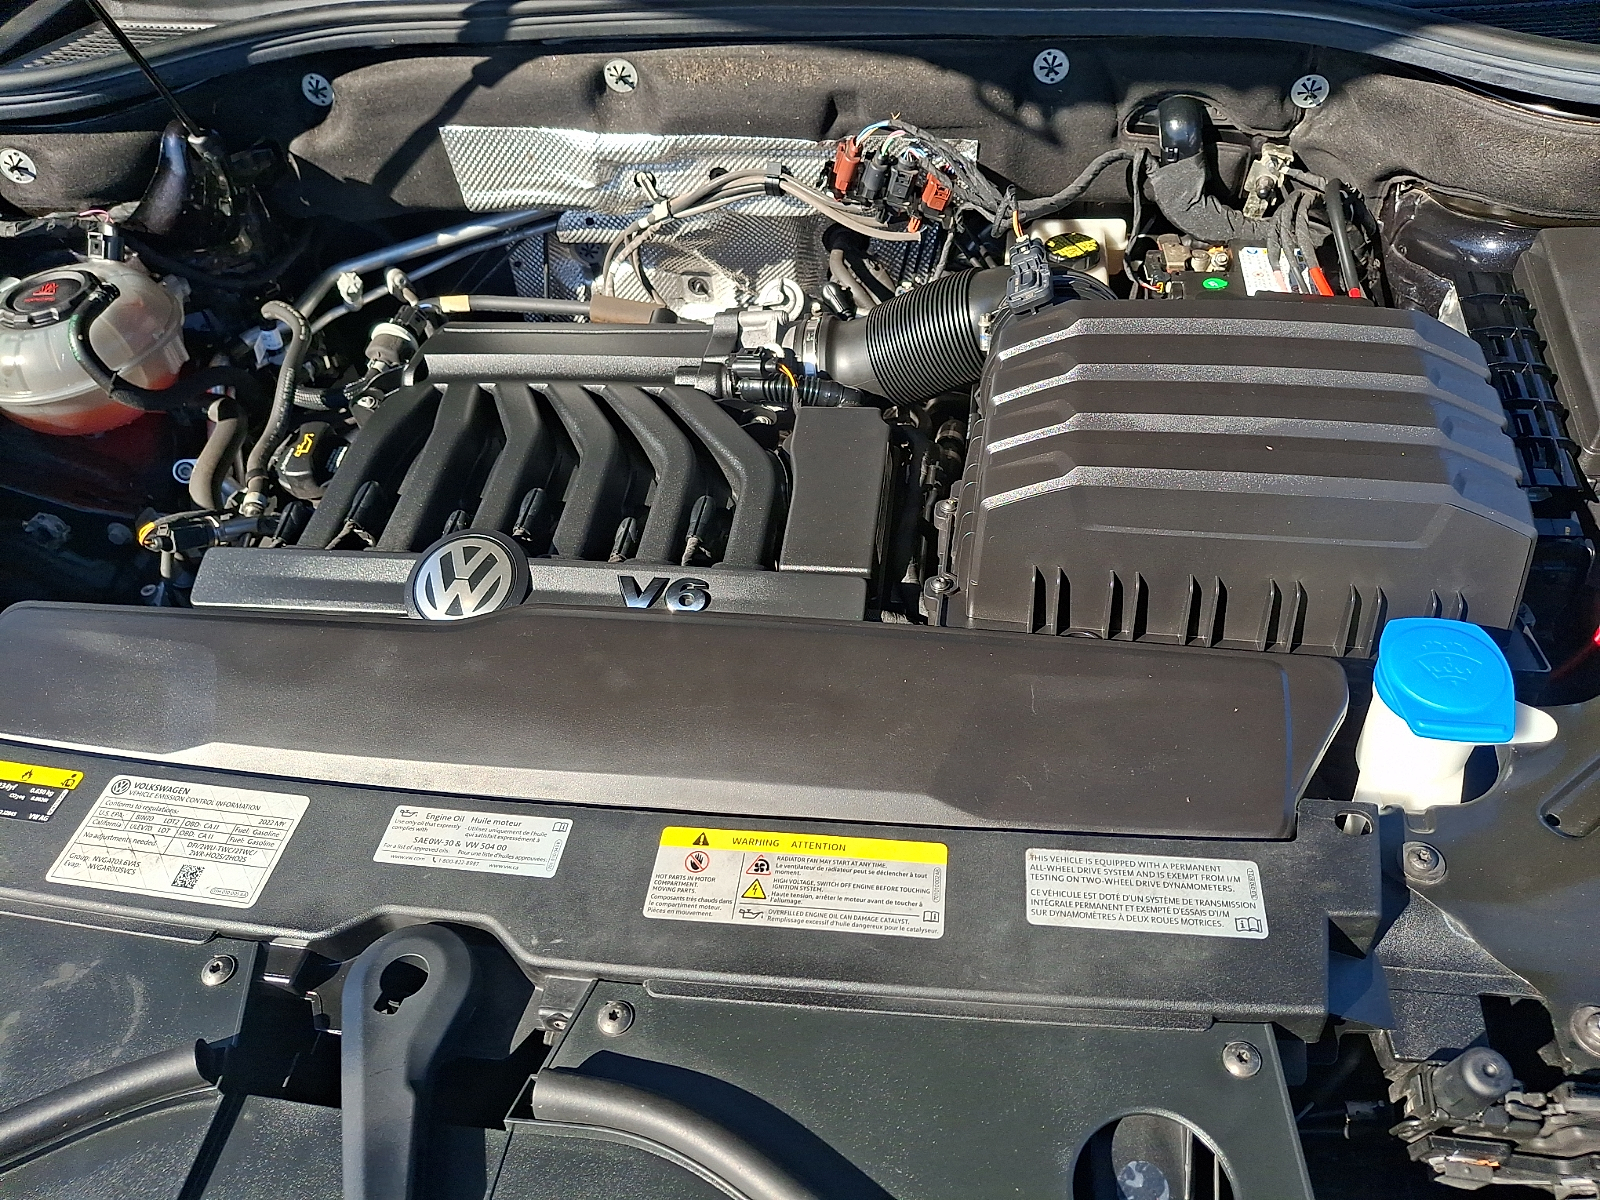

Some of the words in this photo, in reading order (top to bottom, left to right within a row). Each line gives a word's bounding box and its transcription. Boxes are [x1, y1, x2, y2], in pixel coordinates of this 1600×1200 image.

[618, 574, 711, 612] V6
[46, 789, 55, 797] kg
[134, 782, 191, 795] VOLKSWAGEN
[105, 799, 134, 808] Conforms
[129, 790, 154, 798] VEHICLE
[154, 793, 185, 802] EMISSION
[185, 796, 214, 806] CONTROL
[215, 800, 260, 811] INFORMATION
[425, 812, 452, 821] Engine
[470, 816, 491, 824] Huile
[492, 819, 522, 827] moteur
[252, 829, 280, 837] Gasoline
[246, 838, 275, 847] Gasoline
[479, 842, 495, 850] 504
[732, 837, 779, 847] WARNING
[790, 840, 846, 851] ATTENTION
[1049, 855, 1083, 864] VEHICLE
[1085, 857, 1093, 865] IS
[1094, 858, 1136, 867] EQUIPPED
[1137, 860, 1160, 868] WITH
[1170, 862, 1220, 872] PERMANENT
[876, 869, 908, 877] déclencher
[1029, 863, 1075, 873] ALL-WHEEL
[1077, 866, 1101, 875] DRIVE
[1103, 868, 1134, 876] SYSTEM
[1136, 870, 1156, 878] AND
[1157, 871, 1165, 879] IS
[1166, 872, 1198, 880] EXEMPT
[1200, 874, 1225, 882] FROM
[1226, 875, 1241, 883] I/M
[653, 879, 698, 887] COMPARTMENT.
[788, 878, 815, 886] VOLTAGE,
[875, 884, 898, 892] BEFORE
[899, 886, 930, 894] TOUCHING
[1031, 873, 1064, 882] TESTING
[1066, 875, 1079, 883] ON
[1080, 876, 1134, 886] TWO-WHEEL
[1135, 879, 1160, 888] DRIVE
[1162, 881, 1235, 892] DYNAMOMETERS.
[650, 893, 685, 901] Composants
[790, 892, 813, 900] tension,
[1030, 888, 1040, 896] CE
[1041, 889, 1081, 899] VÉHICULE
[1083, 891, 1096, 900] EST
[1098, 892, 1120, 901] DOTÉ
[1122, 894, 1144, 902] D'UN
[1145, 895, 1180, 904] SYSTÈME
[1195, 899, 1256, 909] TRANSMISSION
[647, 906, 665, 914] Pièces
[655, 901, 697, 909] compartiment
[1030, 898, 1072, 908] INTÉGRALE
[1074, 901, 1123, 911] PERMANENT
[1125, 904, 1134, 912] ET
[1135, 905, 1171, 914] EXEMPTÉ
[1172, 907, 1207, 916] D'ESSAIS
[768, 908, 804, 916] OVERFILLED
[853, 914, 878, 922] DAMAGE
[879, 917, 909, 925] CATALYST.
[1030, 908, 1047, 916] SUR
[1049, 909, 1116, 921] DYNAMOMÈTRES
[1125, 914, 1149, 923] DEUX
[1150, 916, 1179, 925] ROUES
[1180, 917, 1224, 927] MOTRICES.
[766, 915, 804, 925] Remplissage
[851, 921, 883, 929] dangereux
[906, 926, 937, 934] catalyseur.
